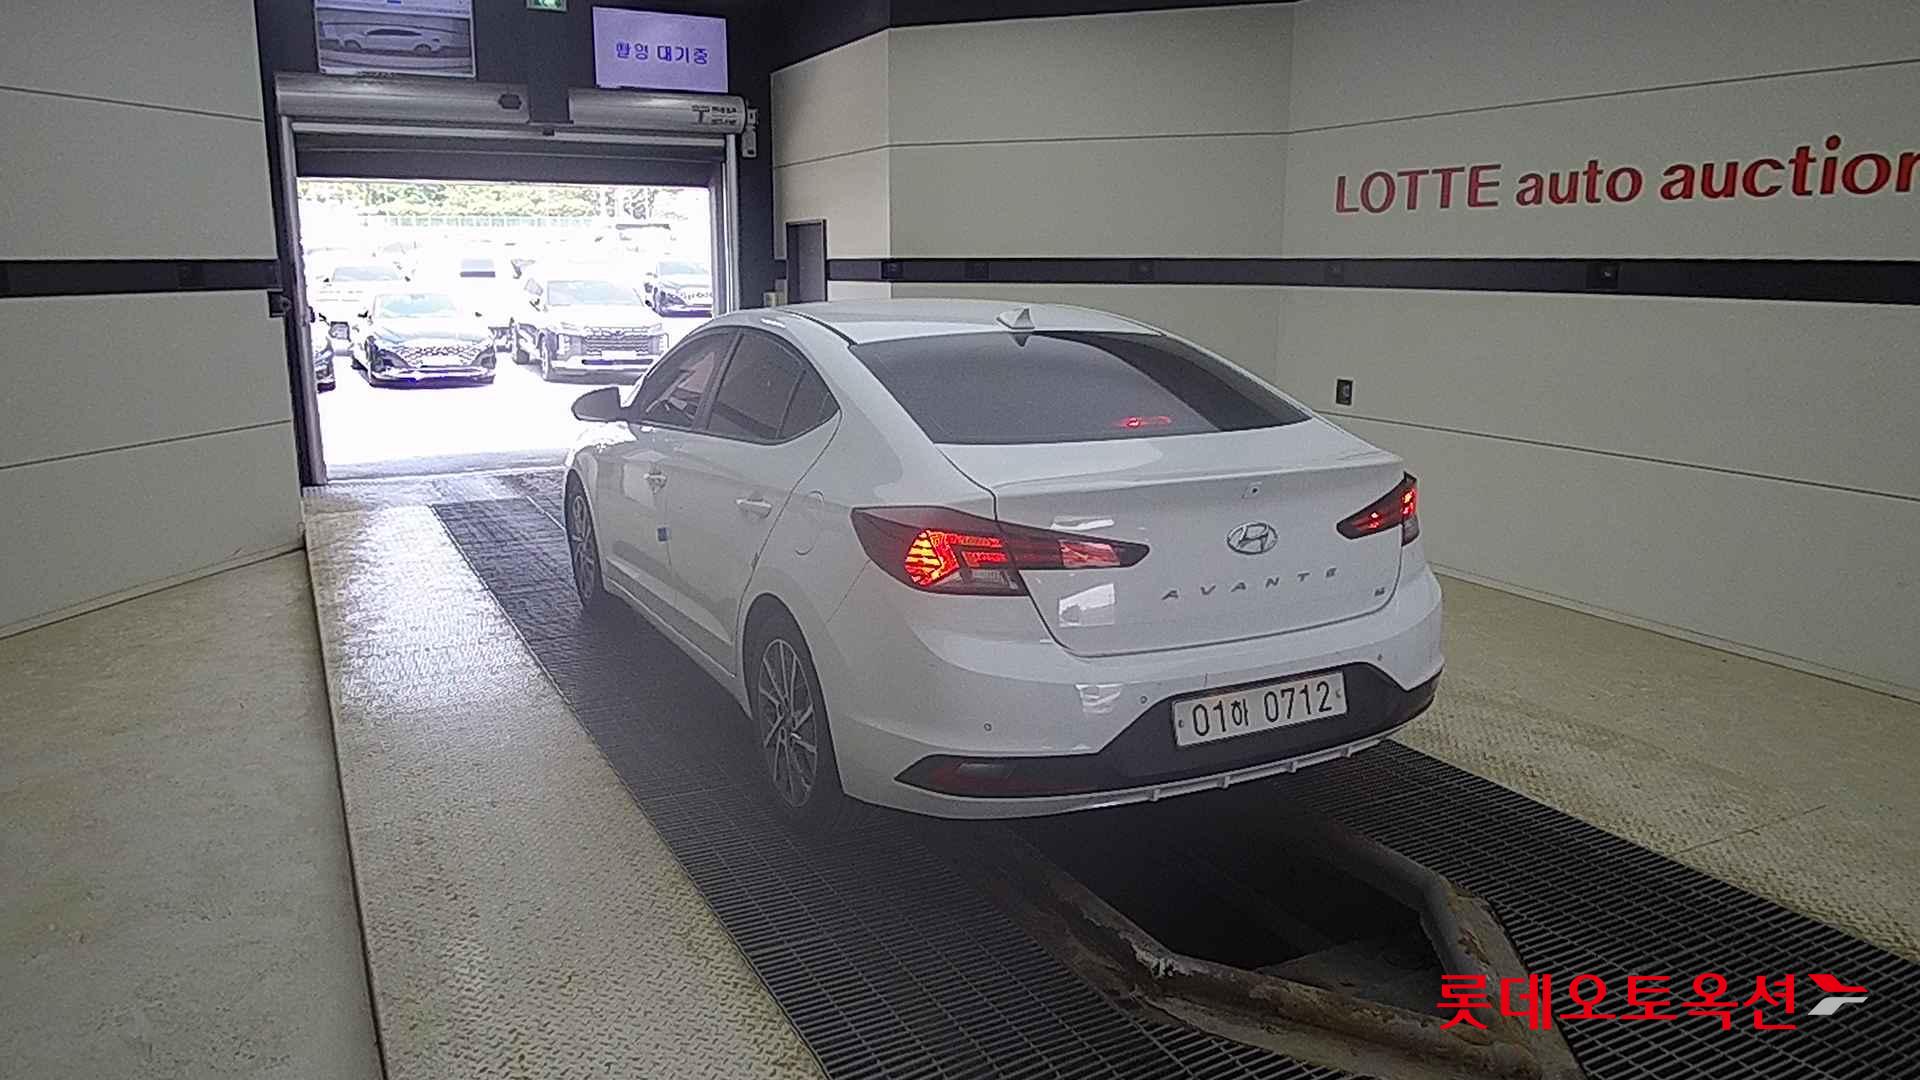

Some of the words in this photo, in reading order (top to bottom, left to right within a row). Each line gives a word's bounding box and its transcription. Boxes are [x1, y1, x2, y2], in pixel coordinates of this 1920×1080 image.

[657, 45, 708, 65] 대기중
[1336, 163, 1502, 213] LOTTE
[1515, 159, 1643, 207] auto
[1162, 567, 1338, 600] AVANTE
[1192, 698, 1250, 737] 01하
[1264, 681, 1332, 723] 0712
